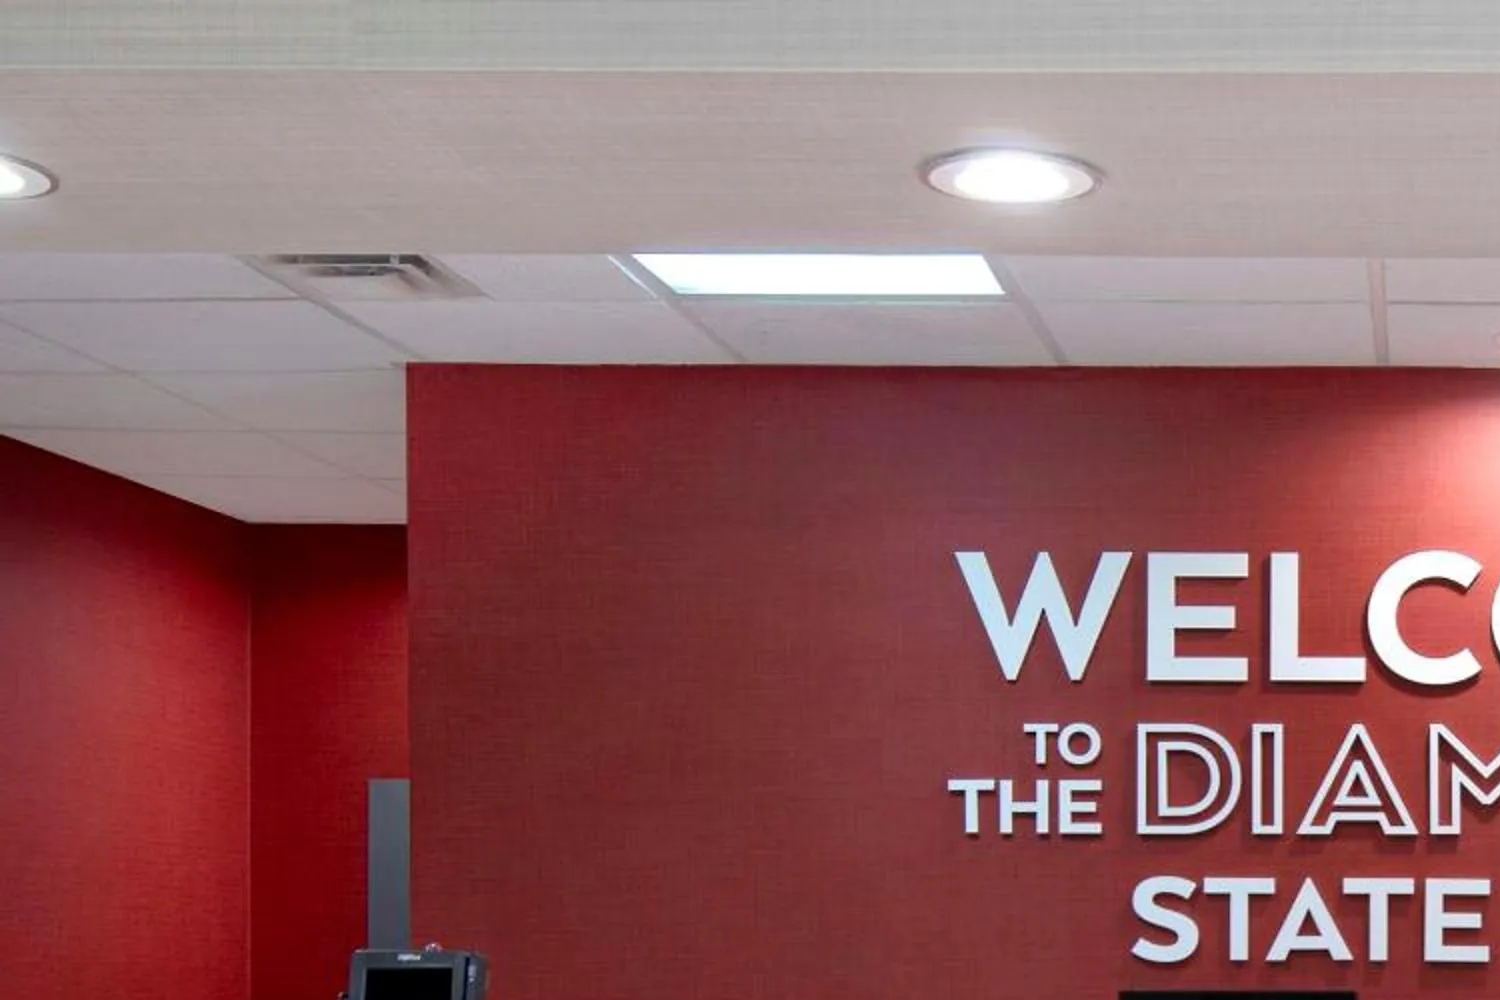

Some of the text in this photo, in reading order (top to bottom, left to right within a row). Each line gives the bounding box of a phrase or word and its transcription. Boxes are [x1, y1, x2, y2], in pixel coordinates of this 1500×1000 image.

[1023, 721, 1103, 766] TO
[946, 777, 1104, 836] THE
[1130, 875, 1491, 964] STATE
